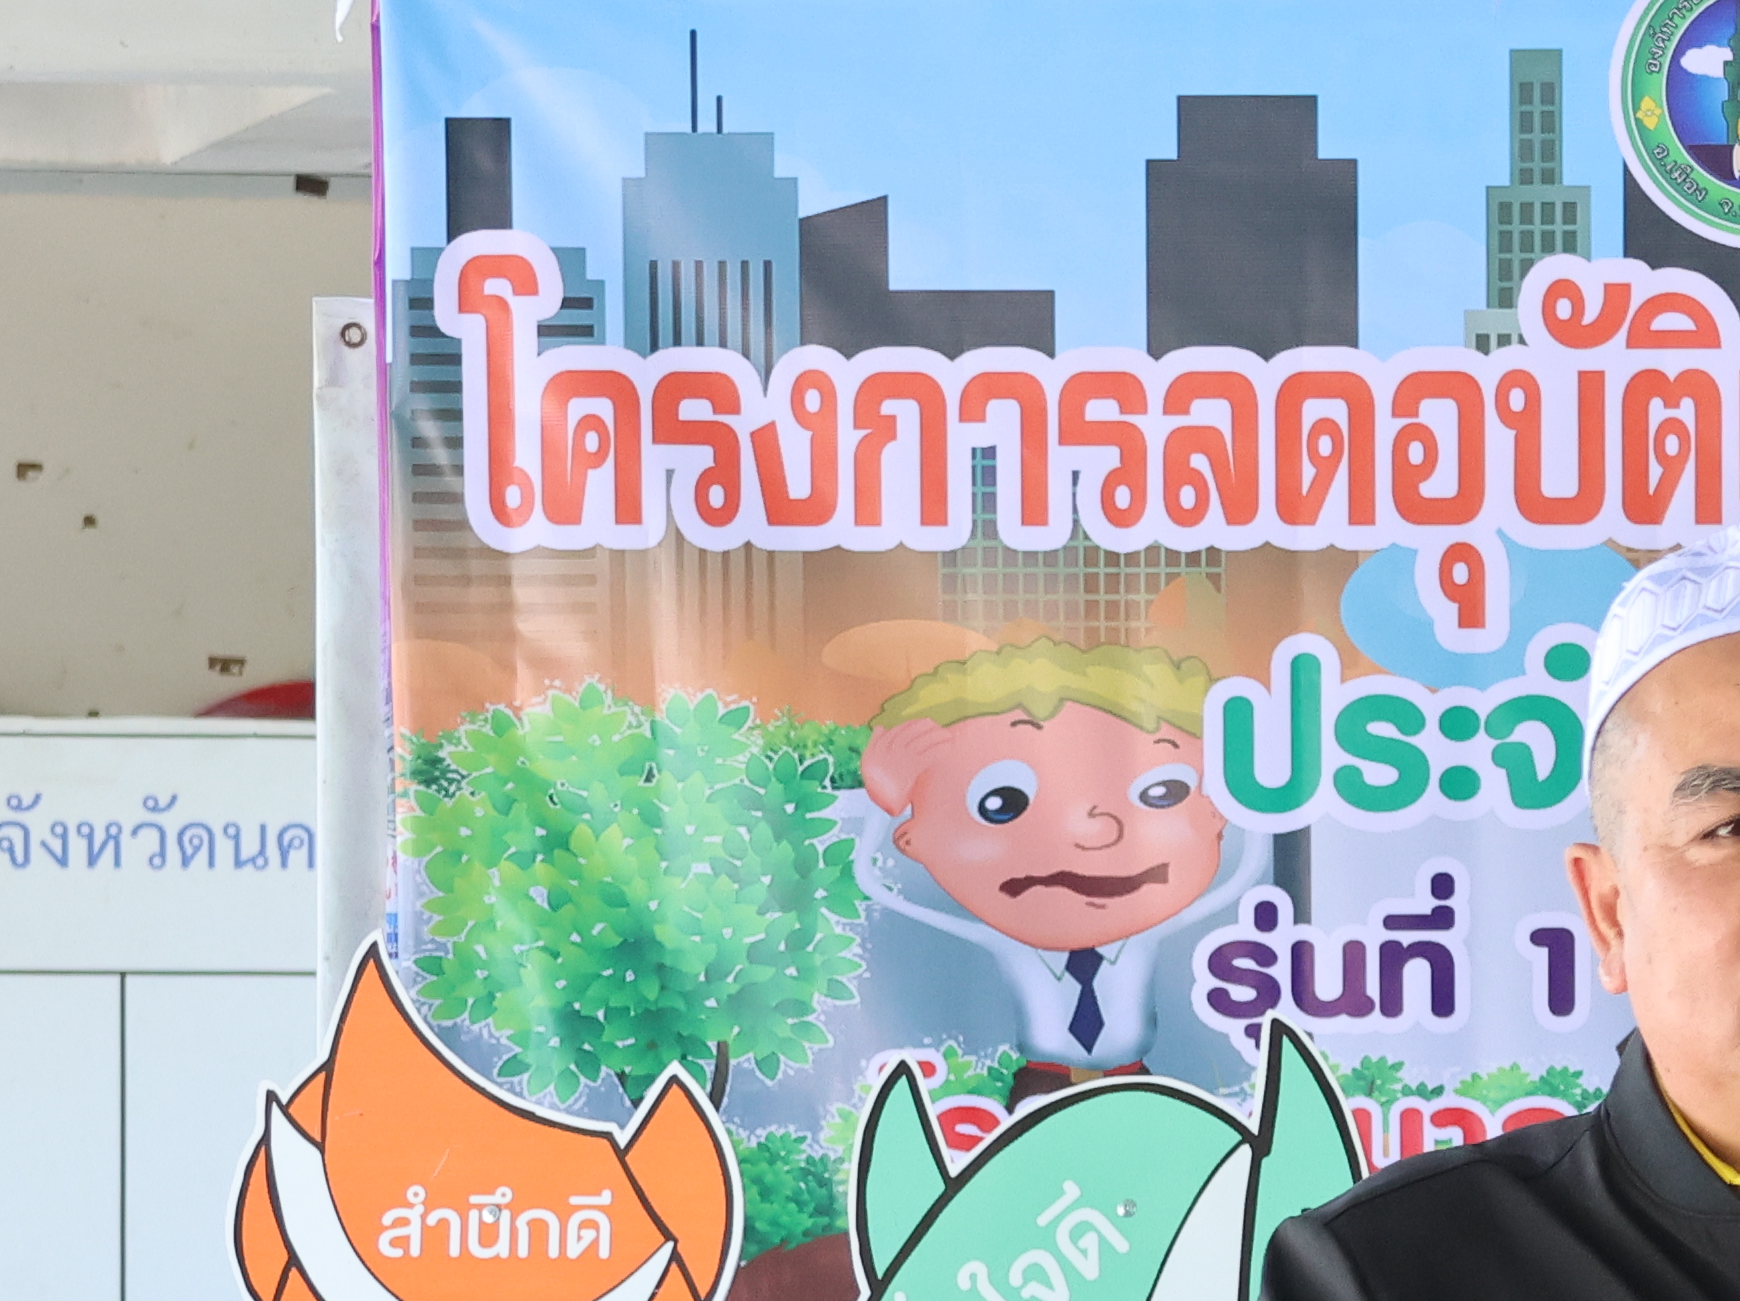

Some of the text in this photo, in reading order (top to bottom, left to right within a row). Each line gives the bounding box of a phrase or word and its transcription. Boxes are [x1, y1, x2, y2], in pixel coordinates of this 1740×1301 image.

[1528, 926, 1577, 1018] 1
[377, 1184, 613, 1260] สำนึกดี
